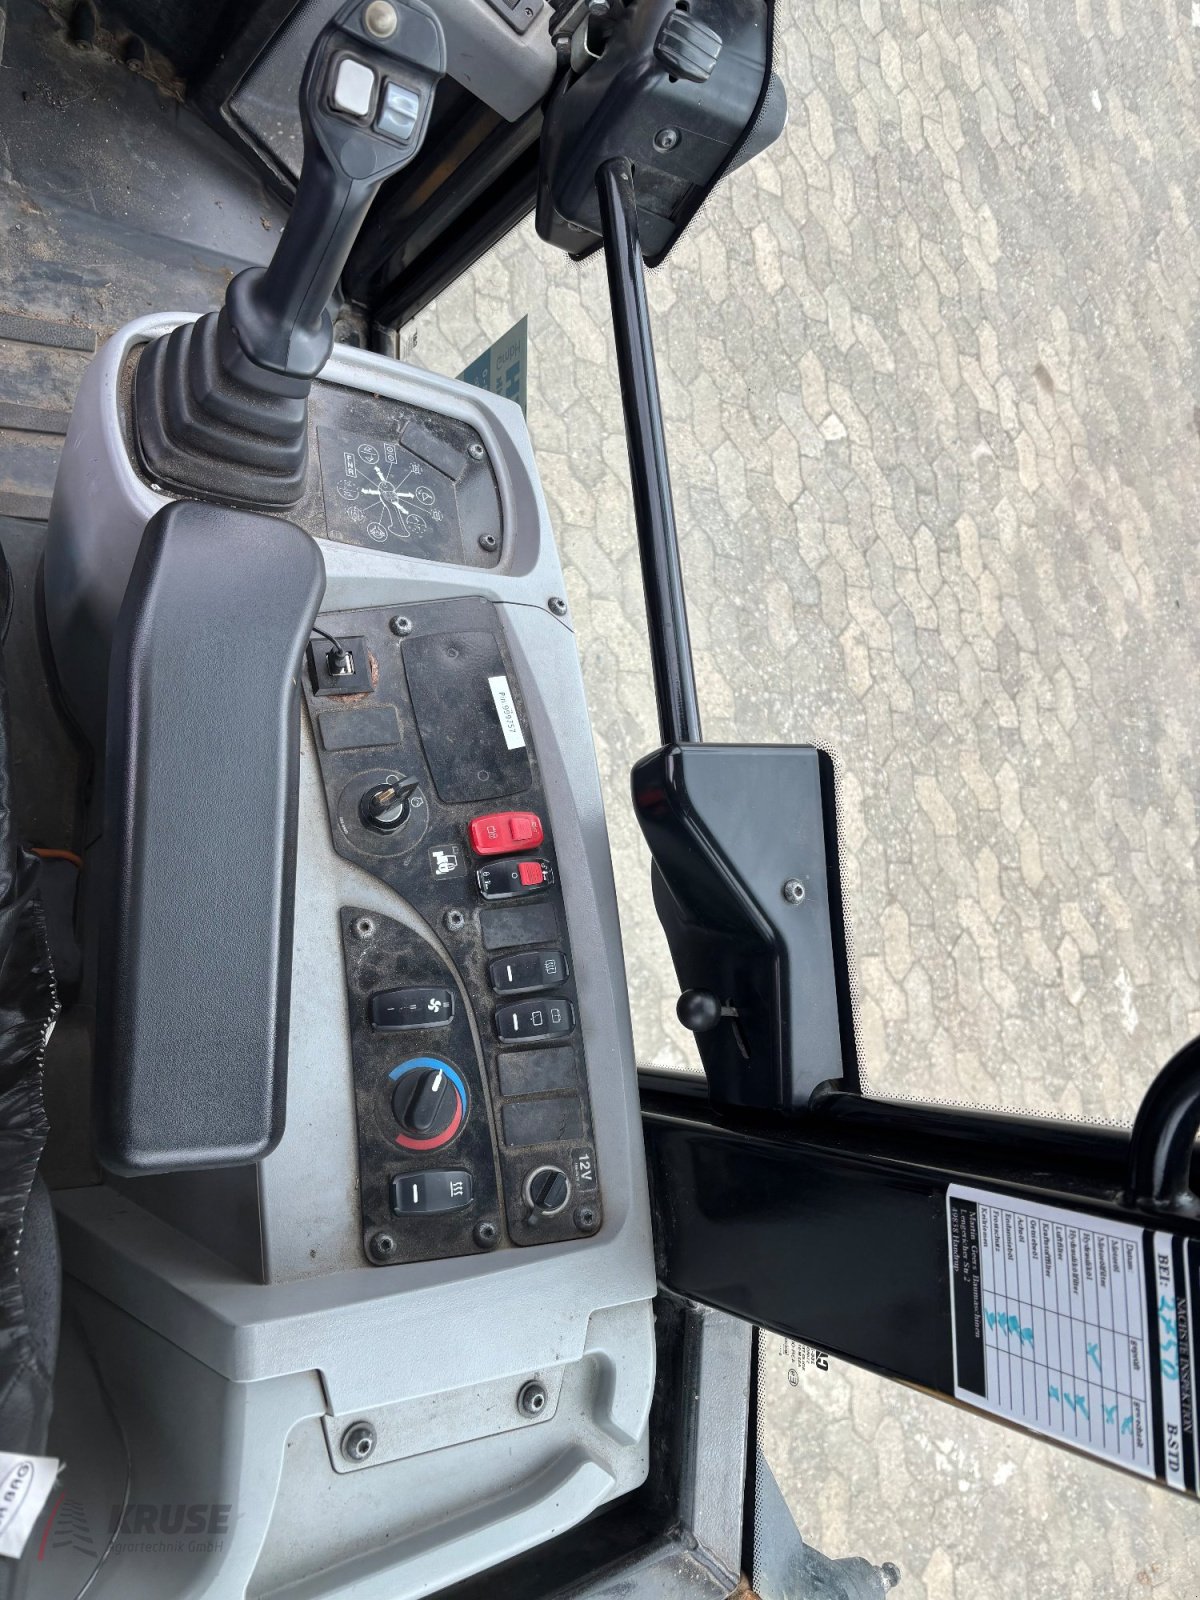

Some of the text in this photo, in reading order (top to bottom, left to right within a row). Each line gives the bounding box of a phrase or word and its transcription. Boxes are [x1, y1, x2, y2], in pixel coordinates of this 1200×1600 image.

[579, 1153, 592, 1180] 12V
[969, 1211, 978, 1240] Martin
[952, 1235, 960, 1272] Handrup
[1158, 1254, 1170, 1287] BEI:
[972, 1274, 982, 1338] Baumaschinen
[1180, 1358, 1192, 1434] INSPEKTION
[1167, 1422, 1180, 1472] B-STD
